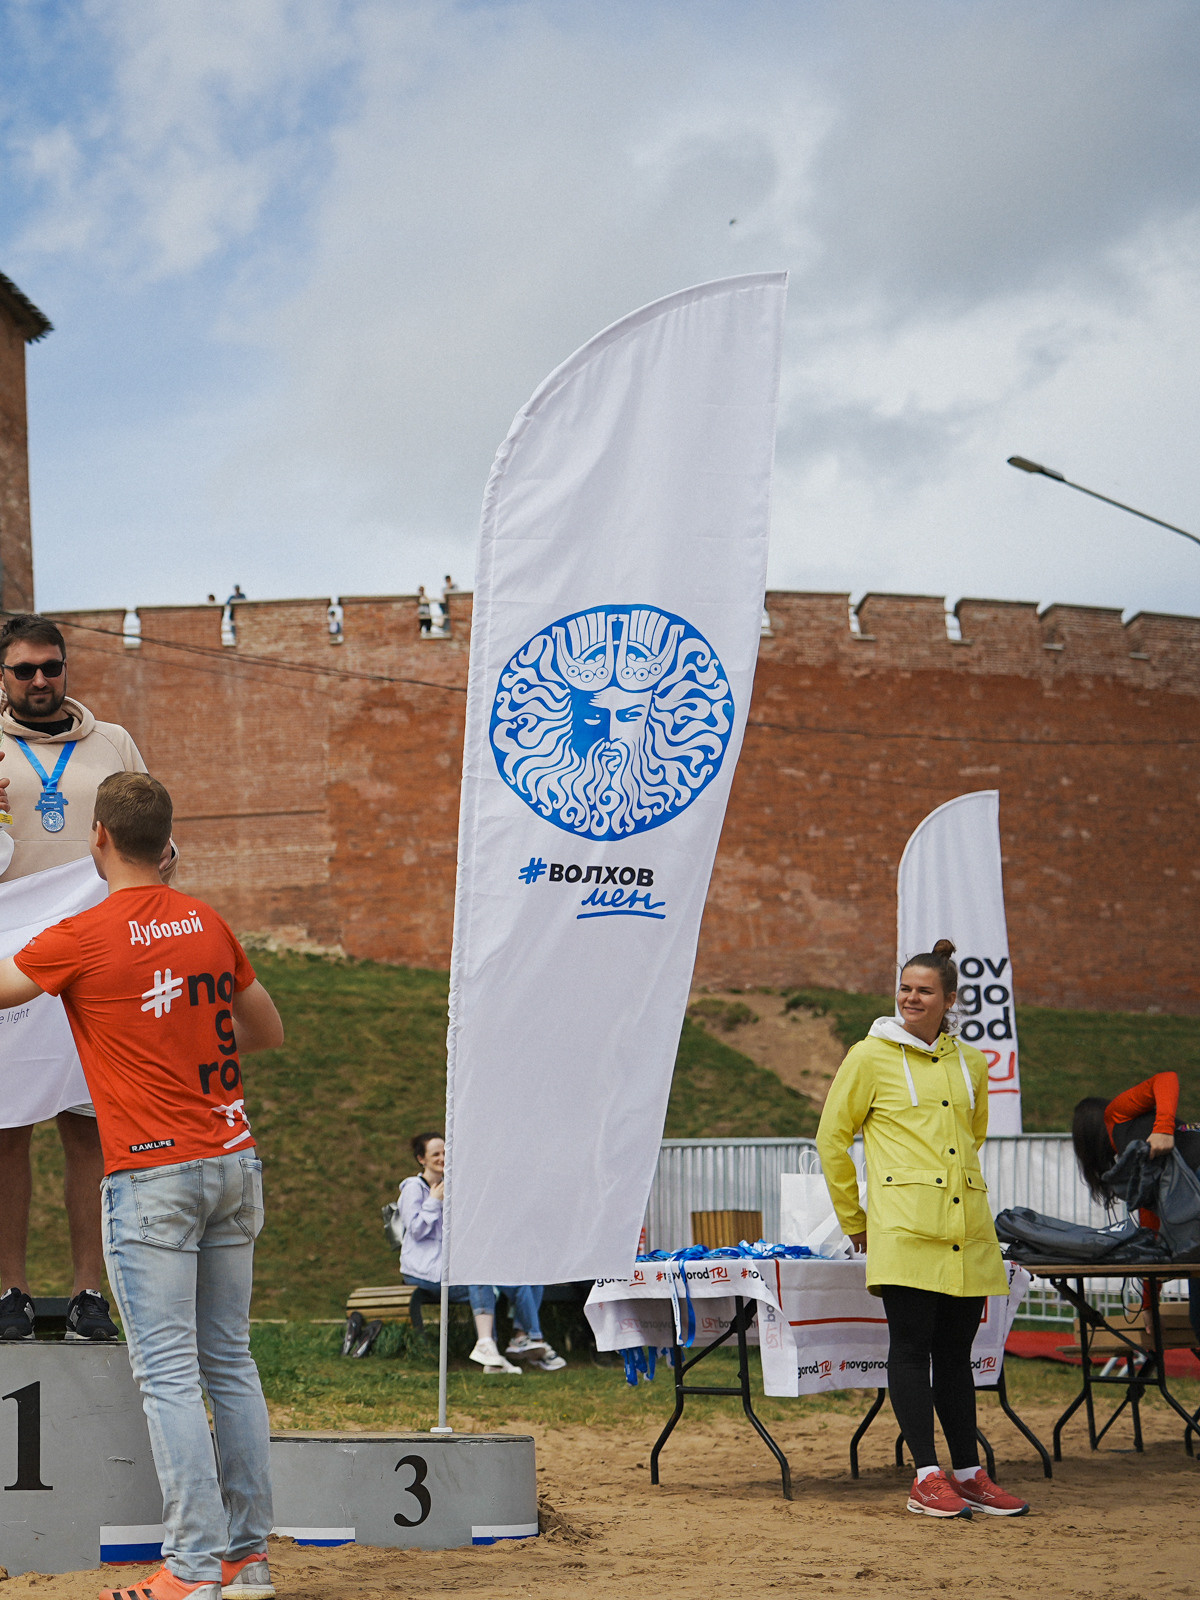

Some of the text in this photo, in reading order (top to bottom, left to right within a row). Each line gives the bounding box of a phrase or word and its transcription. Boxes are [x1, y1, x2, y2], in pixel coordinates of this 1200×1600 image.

[581, 887, 666, 910] мен
[128, 910, 203, 946] Дубовой
[960, 957, 1008, 978] ov
[8, 1007, 30, 1024] light
[960, 1006, 1013, 1042] od
[2, 1381, 54, 1491] 1
[393, 1454, 432, 1527] 3
